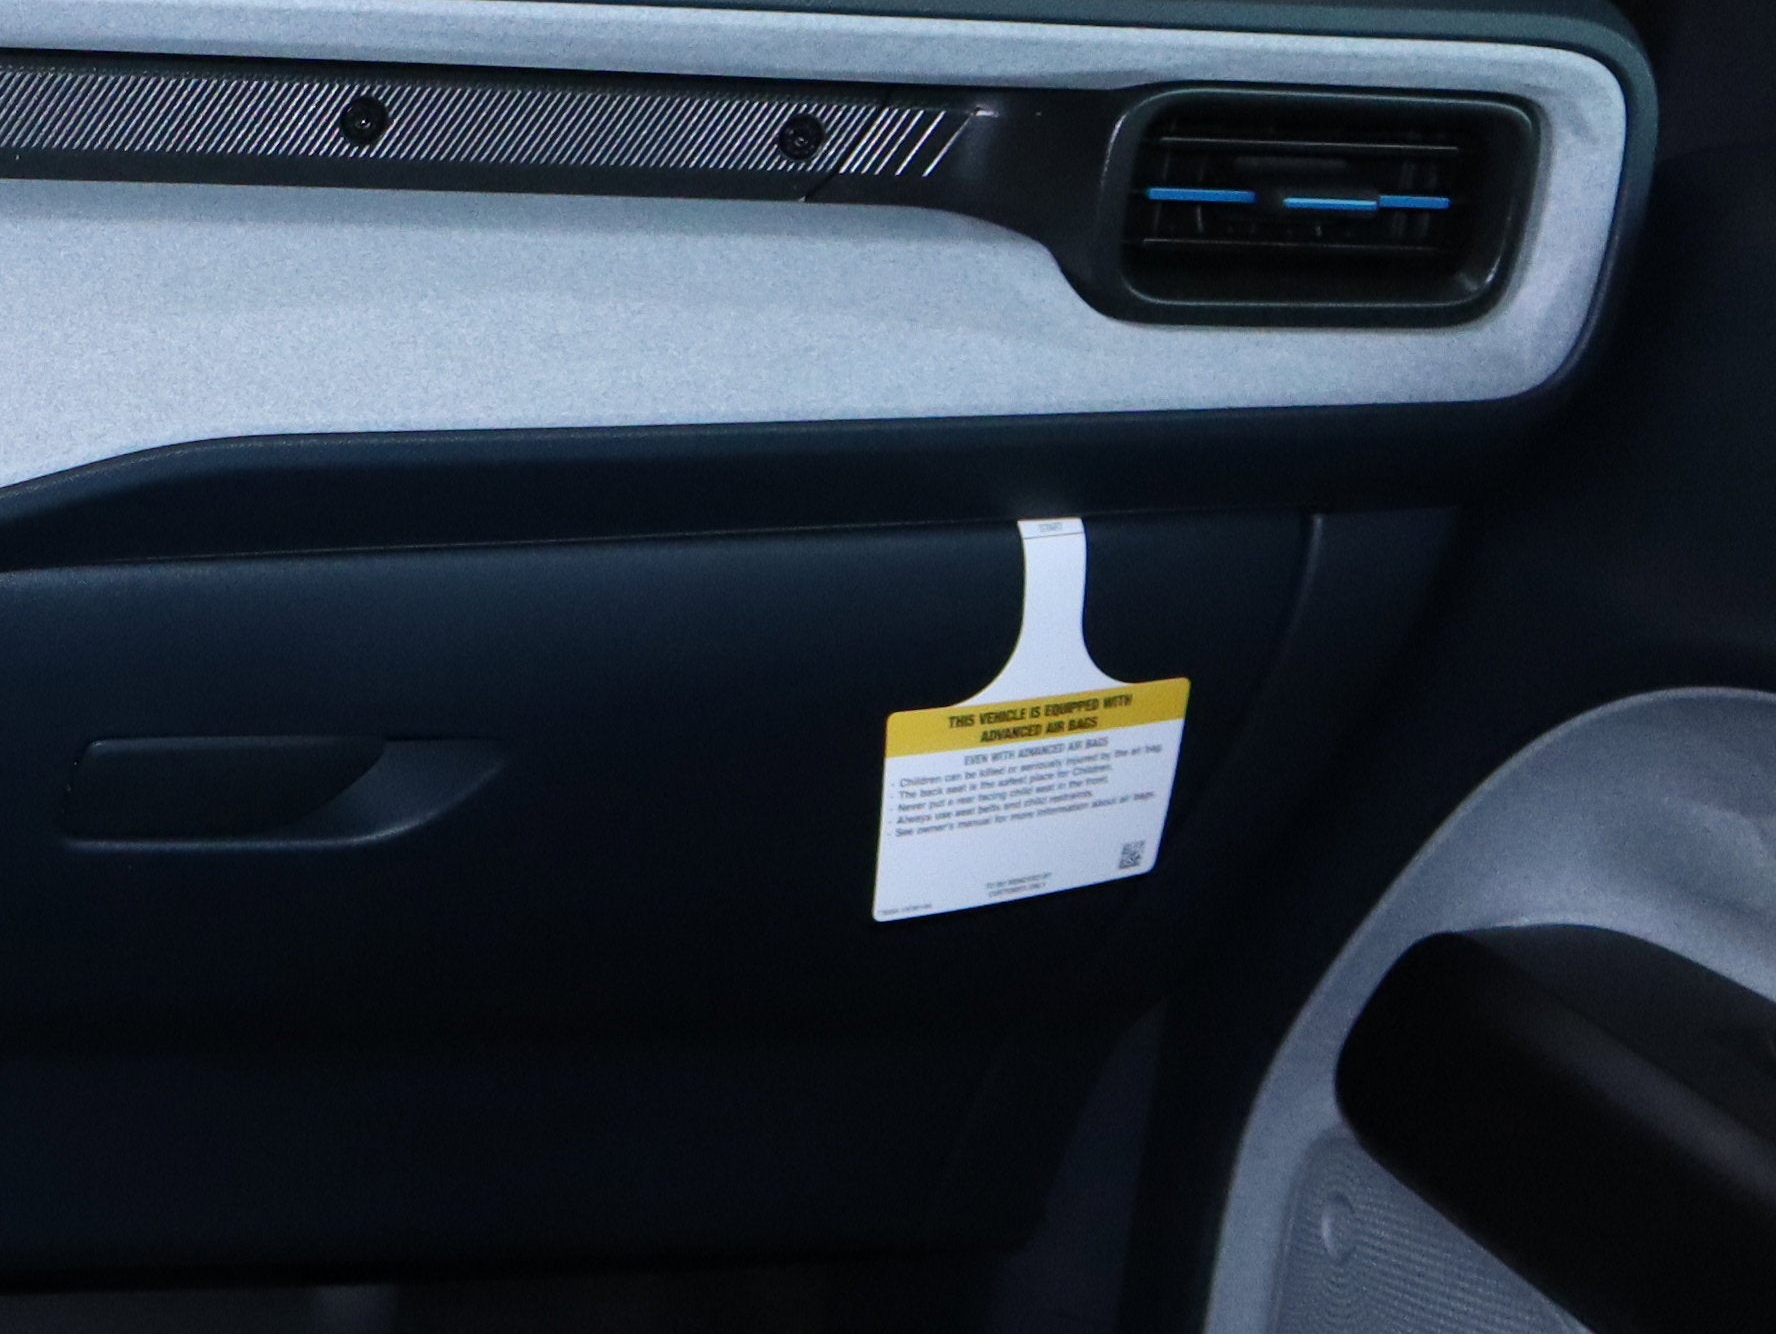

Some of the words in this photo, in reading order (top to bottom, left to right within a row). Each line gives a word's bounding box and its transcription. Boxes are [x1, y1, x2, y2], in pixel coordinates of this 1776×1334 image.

[949, 714, 975, 729] THIS
[979, 707, 1026, 725] VEHICLE
[1029, 706, 1042, 719] IS
[1044, 698, 1100, 717] EQUIPPED
[1102, 694, 1133, 709] WITH
[980, 724, 1042, 743] ADVANCED
[1045, 721, 1065, 734] AIR
[1067, 716, 1099, 731] BAGS
